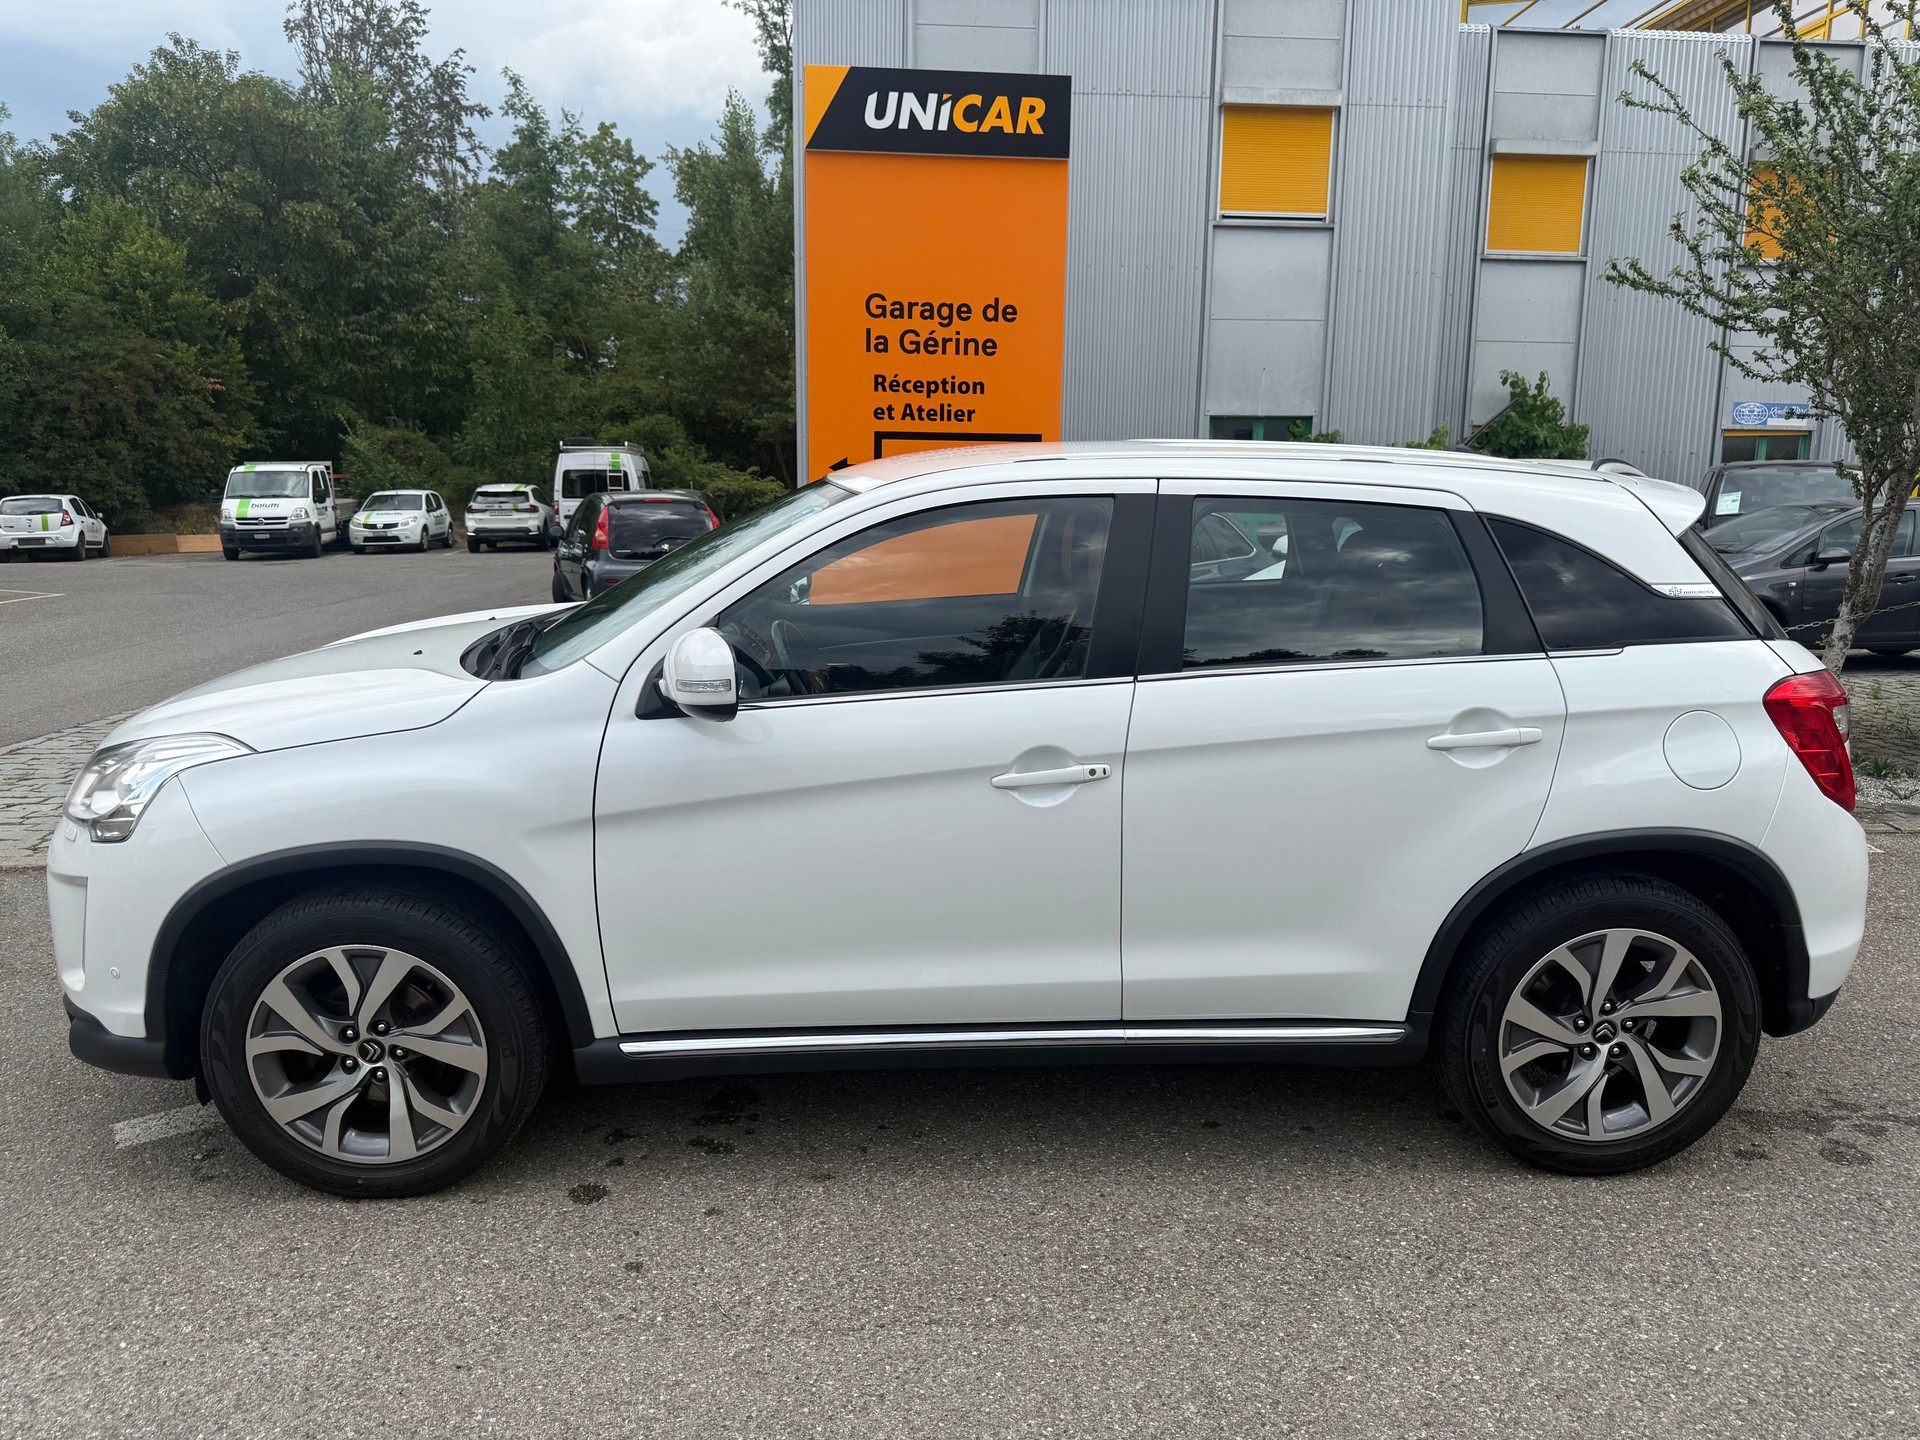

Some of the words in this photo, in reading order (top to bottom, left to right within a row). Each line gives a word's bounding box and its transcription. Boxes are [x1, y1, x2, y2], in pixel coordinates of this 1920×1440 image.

[865, 292, 973, 327] Garage
[982, 298, 1018, 323] de
[865, 328, 889, 354] la
[899, 330, 998, 357] Gérine
[873, 373, 985, 398] Réception
[873, 403, 895, 421] et
[901, 403, 976, 423] Atelier
